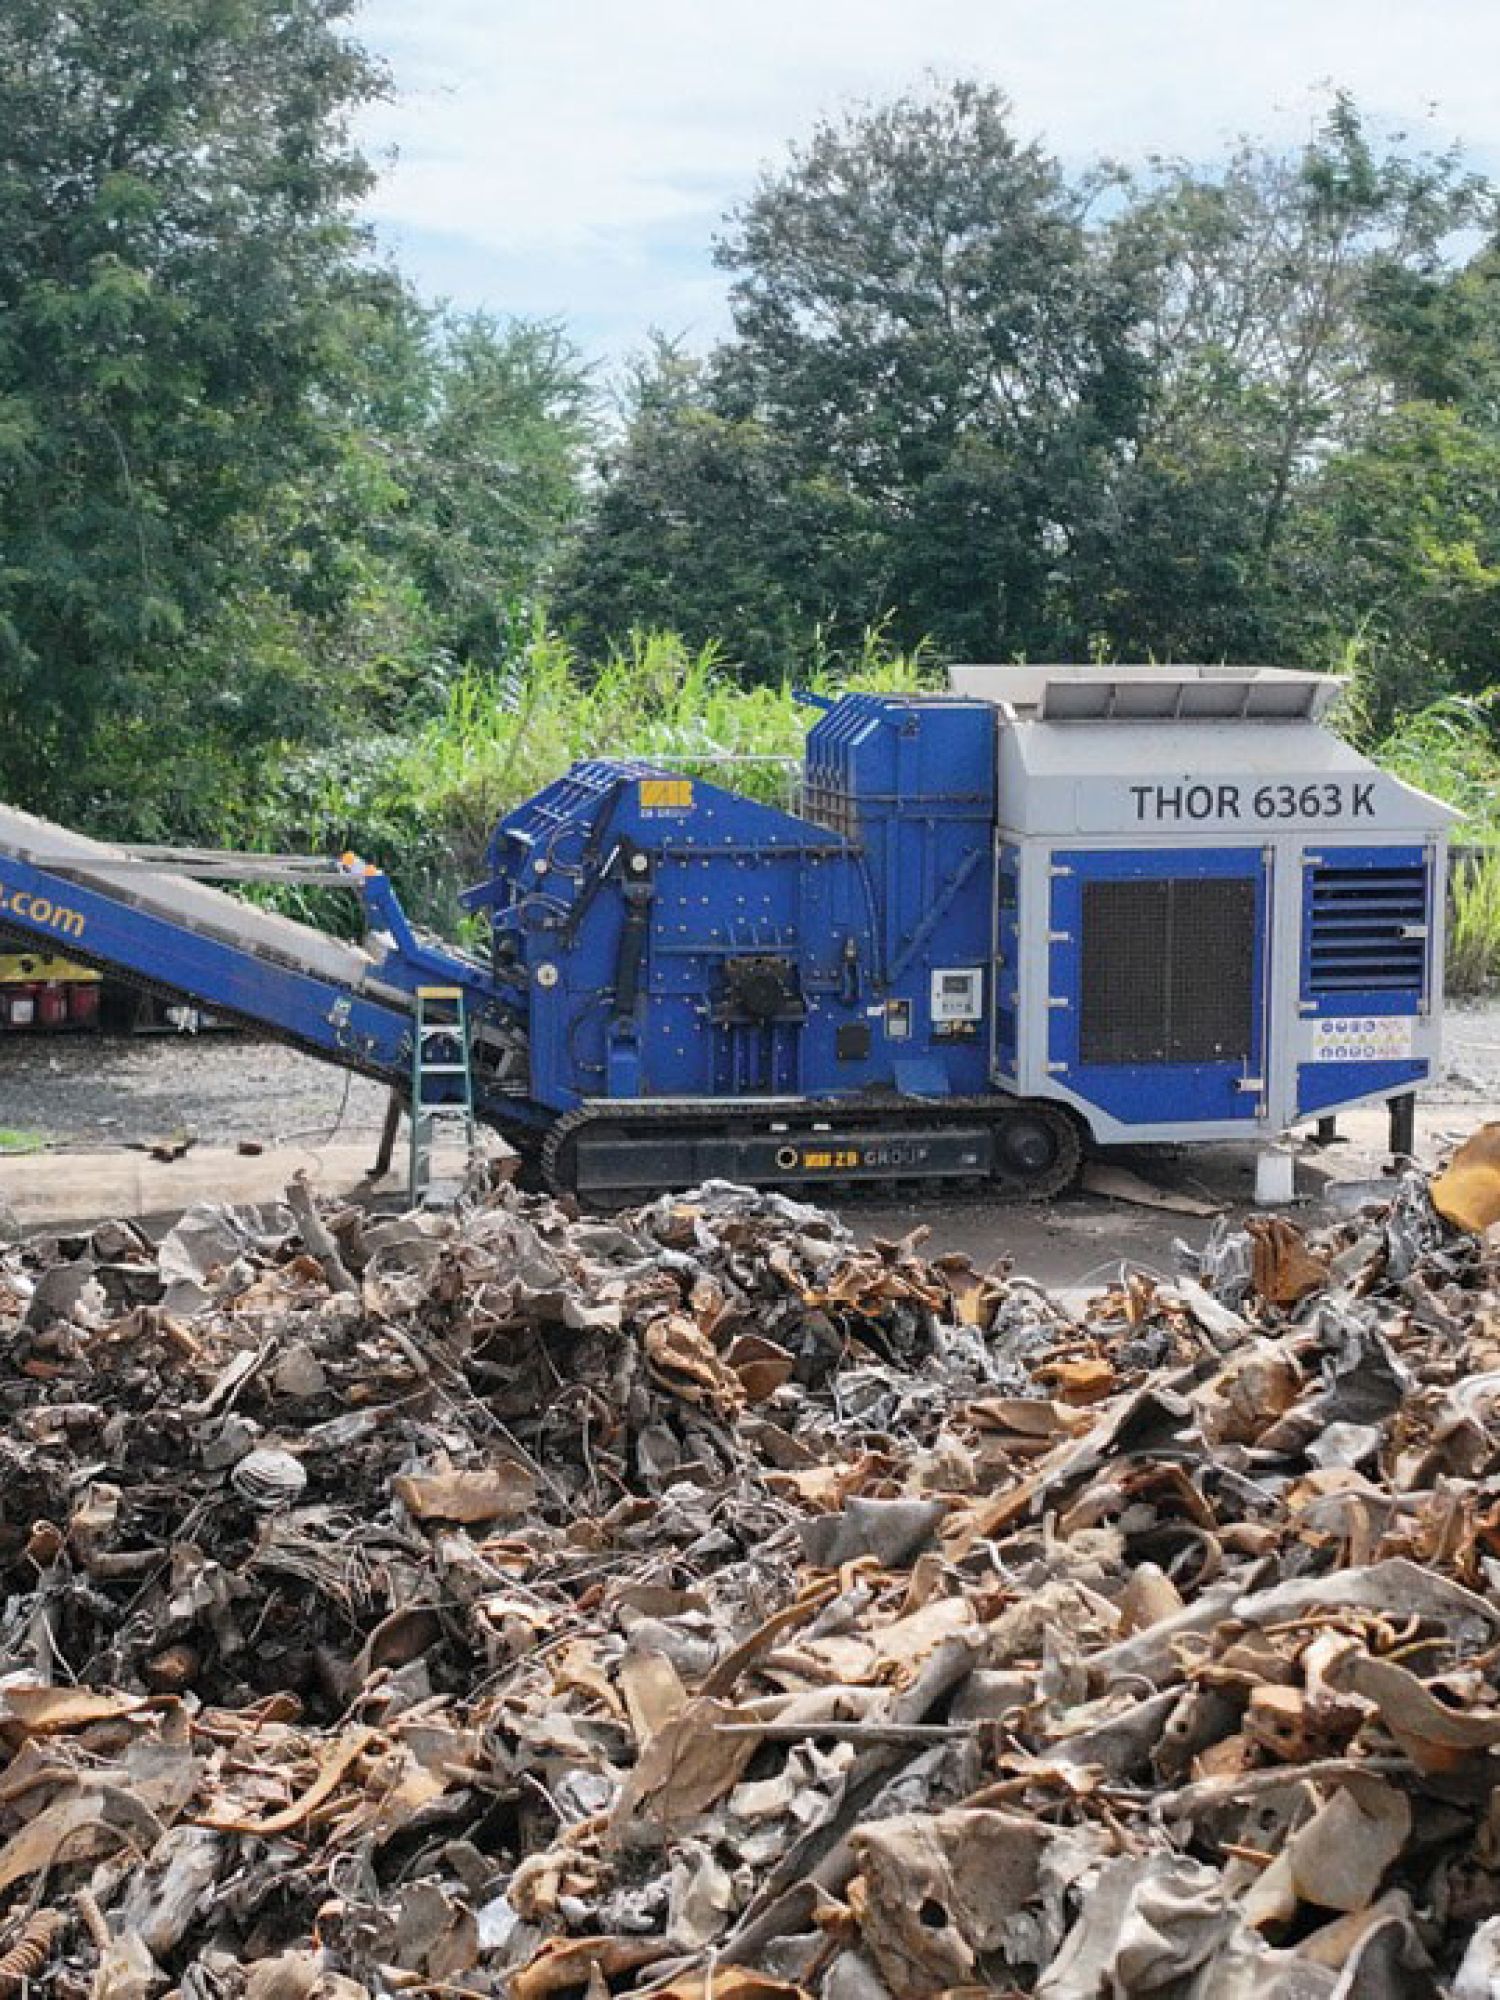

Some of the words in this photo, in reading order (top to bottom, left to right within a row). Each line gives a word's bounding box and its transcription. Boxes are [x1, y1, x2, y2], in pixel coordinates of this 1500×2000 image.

[1129, 785, 1241, 820] THOR
[1254, 784, 1342, 819] 6363
[1352, 783, 1376, 817] K
[0, 883, 85, 938] .com
